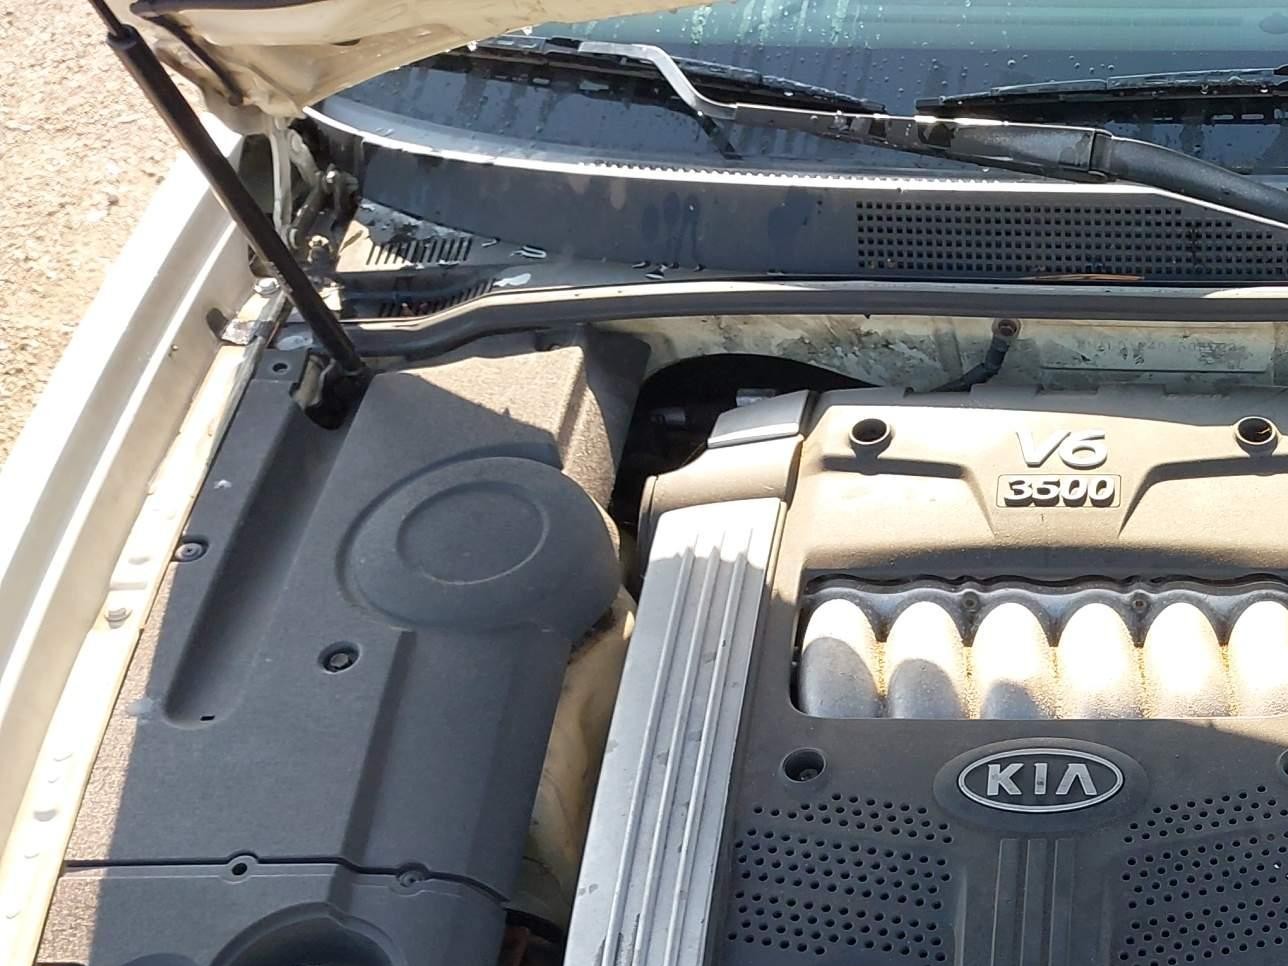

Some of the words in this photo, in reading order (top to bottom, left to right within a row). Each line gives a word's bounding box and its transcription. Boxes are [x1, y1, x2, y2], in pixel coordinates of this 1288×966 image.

[1016, 430, 1108, 471] V6
[1004, 476, 1116, 508] 3500
[986, 763, 1098, 796] KIA
